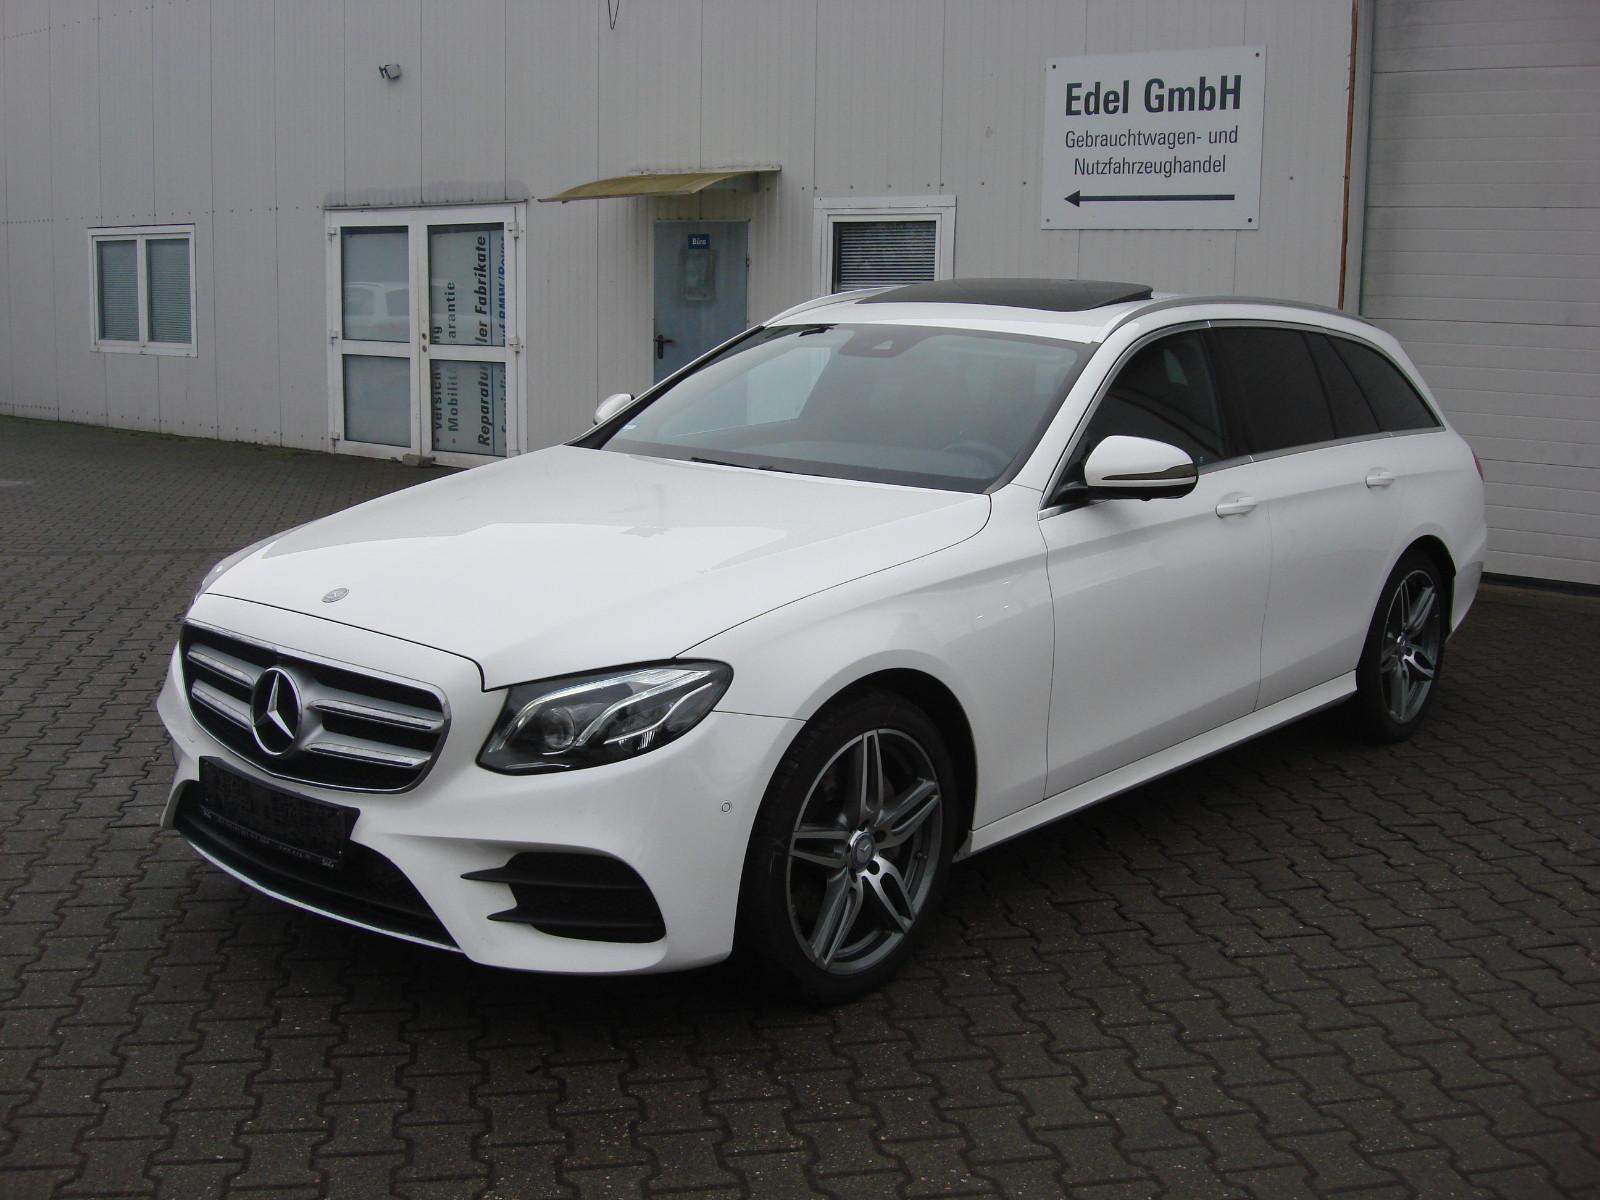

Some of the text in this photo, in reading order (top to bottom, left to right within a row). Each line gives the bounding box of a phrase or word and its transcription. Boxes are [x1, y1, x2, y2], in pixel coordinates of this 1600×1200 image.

[1065, 75, 1242, 116] Edel GmbH
[1065, 125, 1238, 149] Gebrauchtwagen- und
[1074, 154, 1226, 178] Nutzfahrzeughandel
[473, 236, 487, 315] Fabrikate
[477, 365, 492, 447] Reparatur
